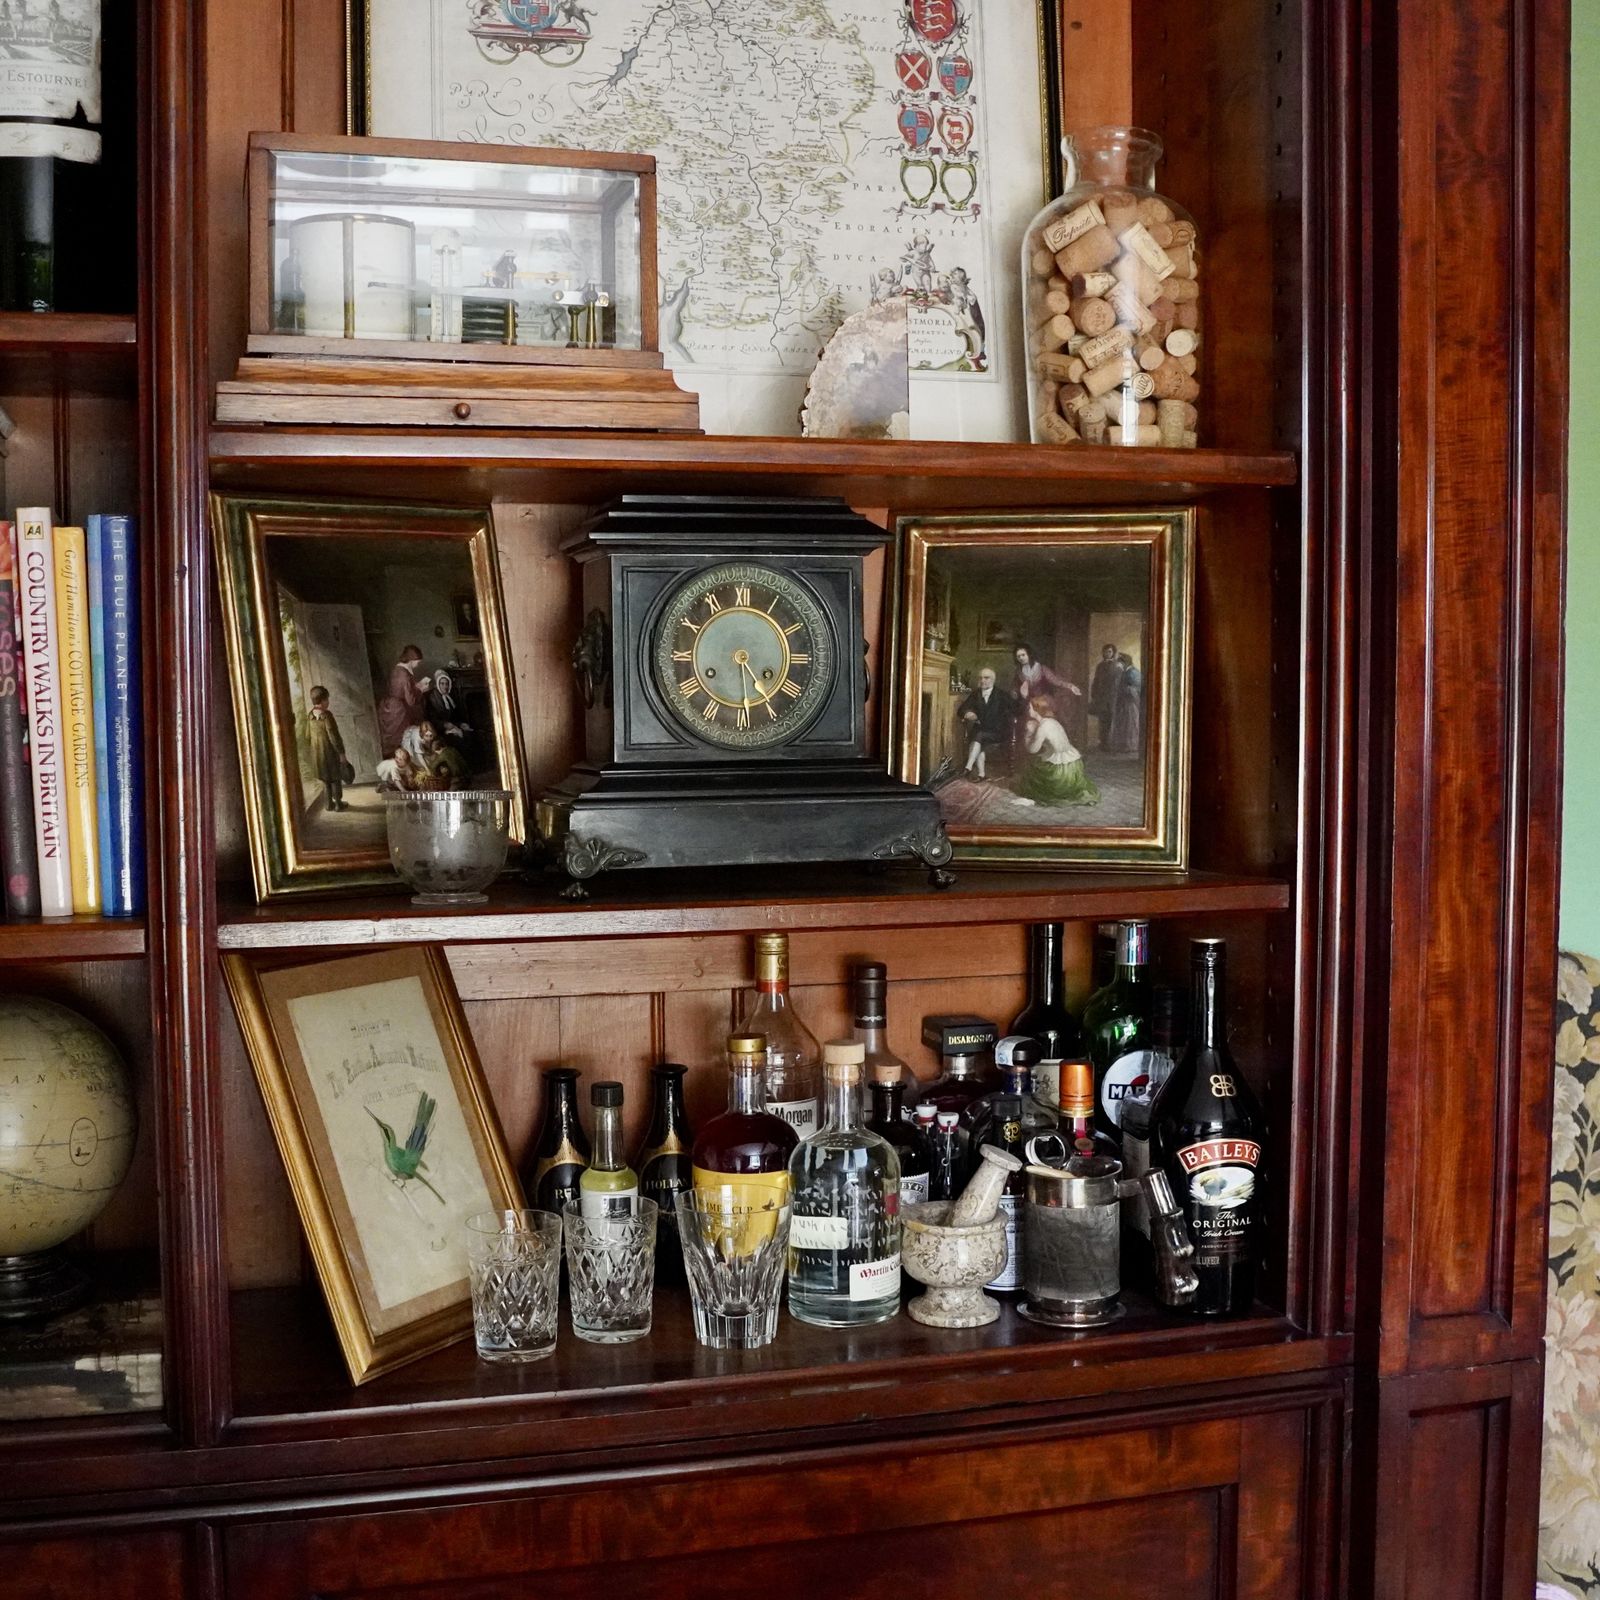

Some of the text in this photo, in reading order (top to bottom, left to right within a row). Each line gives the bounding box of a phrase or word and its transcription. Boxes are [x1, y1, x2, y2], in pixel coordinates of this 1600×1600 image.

[26, 525, 42, 537] AA
[112, 526, 128, 703] THE BLUE PLANET
[68, 650, 86, 716] COTTAGE
[25, 551, 62, 859] COUNTRY WALKS IN BRITAIN
[72, 722, 90, 789] GARDENS
[947, 1034, 994, 1047] DISARONNO
[1110, 1085, 1146, 1099] MAR
[774, 1107, 813, 1126] Morgan
[1184, 1143, 1260, 1168] BAILEYS
[1192, 1216, 1252, 1229] ORIGINAL
[1215, 1210, 1236, 1221] The
[1201, 1228, 1245, 1238] Irish Cream
[859, 1265, 889, 1281] Martin
